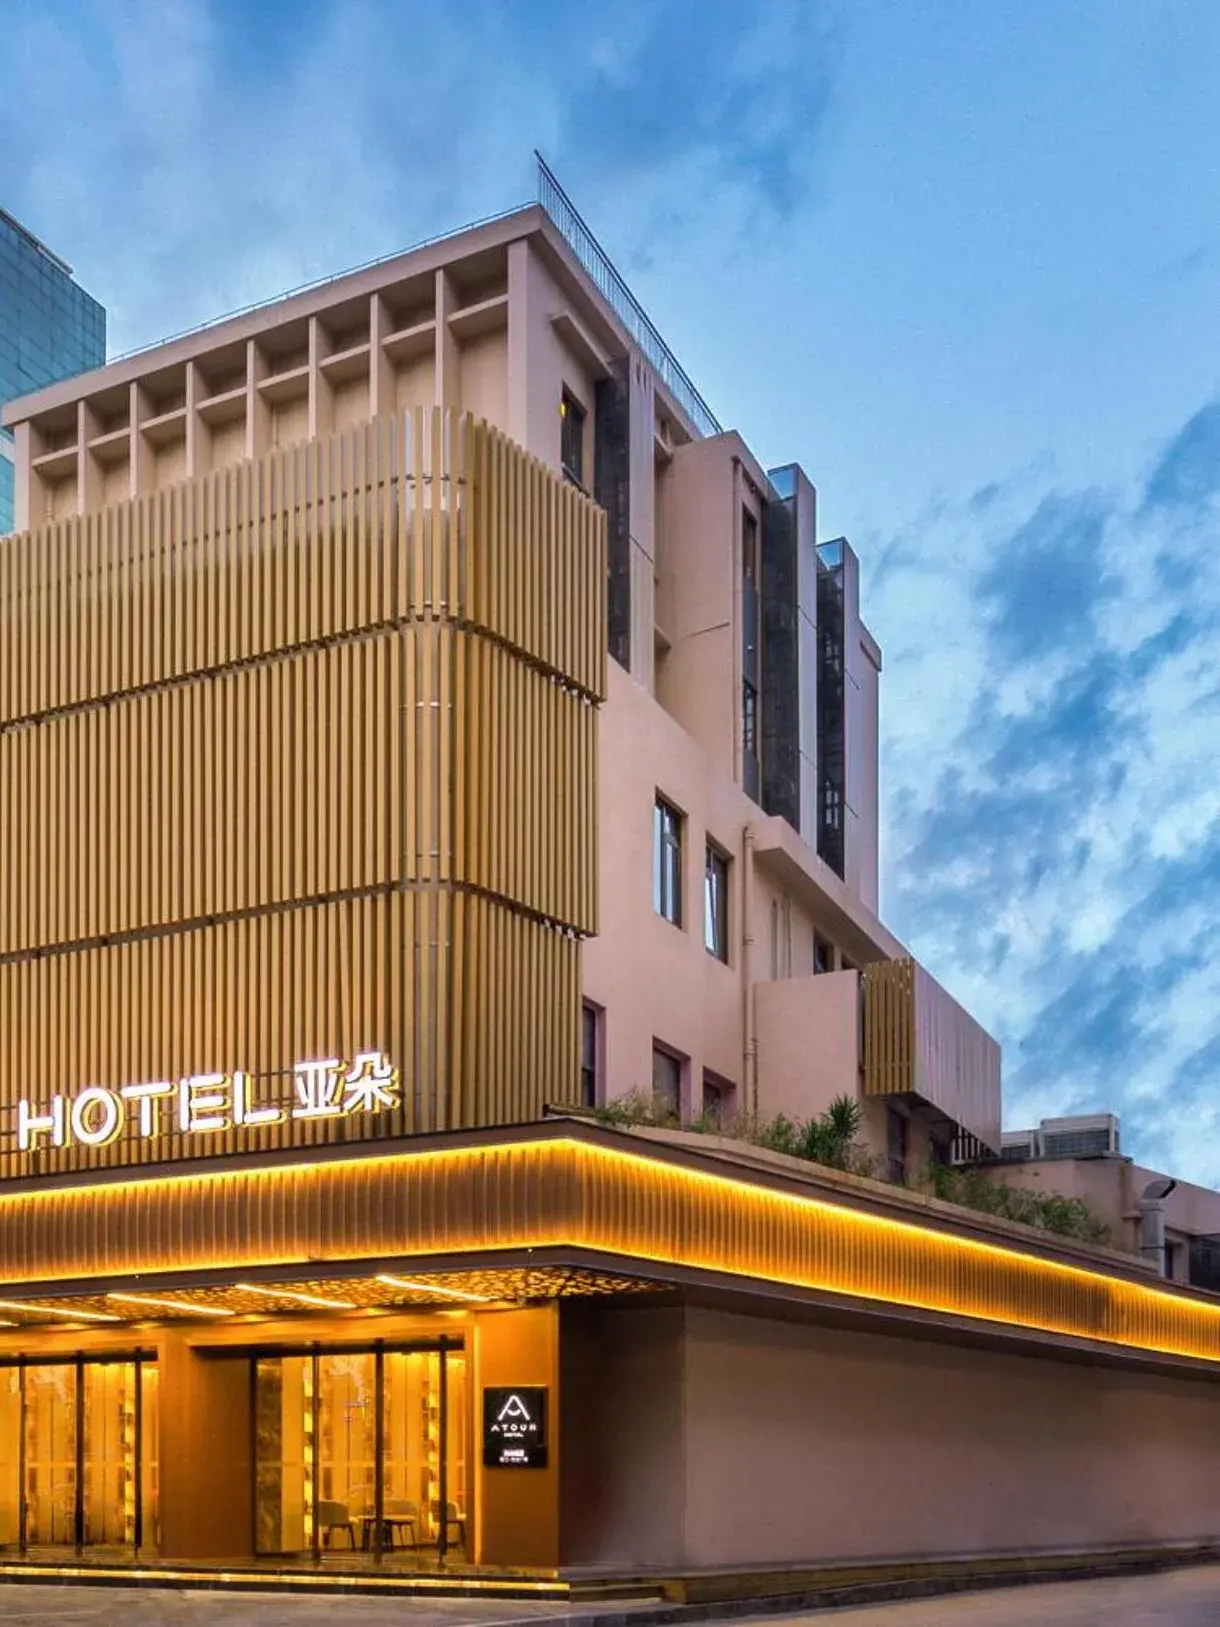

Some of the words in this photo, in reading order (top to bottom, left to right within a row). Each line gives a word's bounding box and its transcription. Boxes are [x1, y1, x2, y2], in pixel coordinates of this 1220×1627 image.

[18, 1071, 287, 1152] HOTEL
[291, 1050, 399, 1120] 亚朵
[490, 1423, 537, 1432] ATOUR
